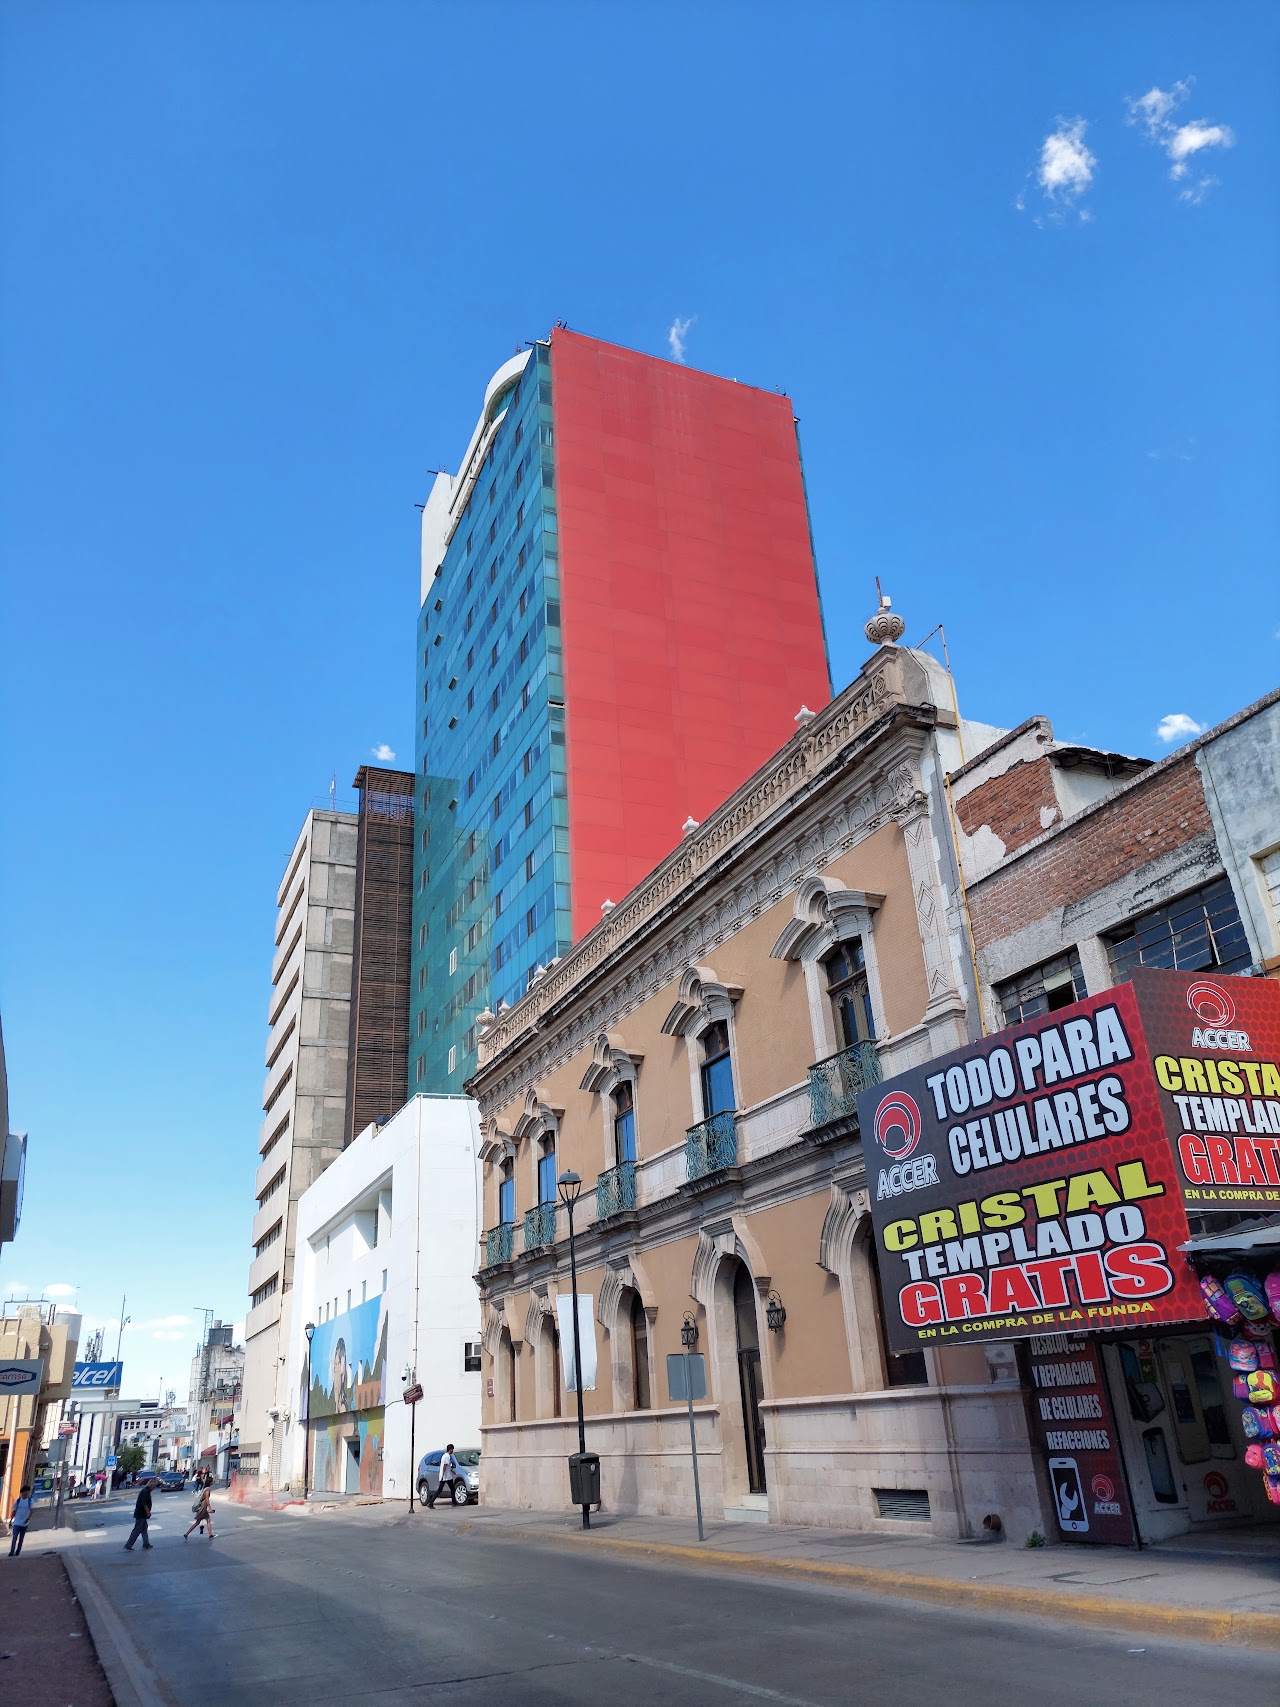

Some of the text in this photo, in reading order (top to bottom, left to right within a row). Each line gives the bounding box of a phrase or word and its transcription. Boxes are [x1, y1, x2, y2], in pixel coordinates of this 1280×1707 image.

[1192, 1026, 1253, 1051] ACCER
[926, 1007, 1132, 1121] TODO PARA
[948, 1077, 1129, 1175] CELULARES
[876, 1153, 940, 1201] ACCER
[1184, 1189, 1280, 1201] EN LA COMPRA DE
[883, 1161, 1165, 1252] CRISTAL
[902, 1205, 1146, 1282] TEMPLADO
[900, 1243, 1174, 1328] GRATIS
[917, 1302, 1156, 1340] EN LA COMPRA DE LA FUNDA
[1031, 1360, 1096, 1388] Y REPARACION
[1038, 1394, 1103, 1421] DE CELULARES
[1046, 1429, 1110, 1450] REFACCIONES
[1094, 1502, 1122, 1515] ACCER
